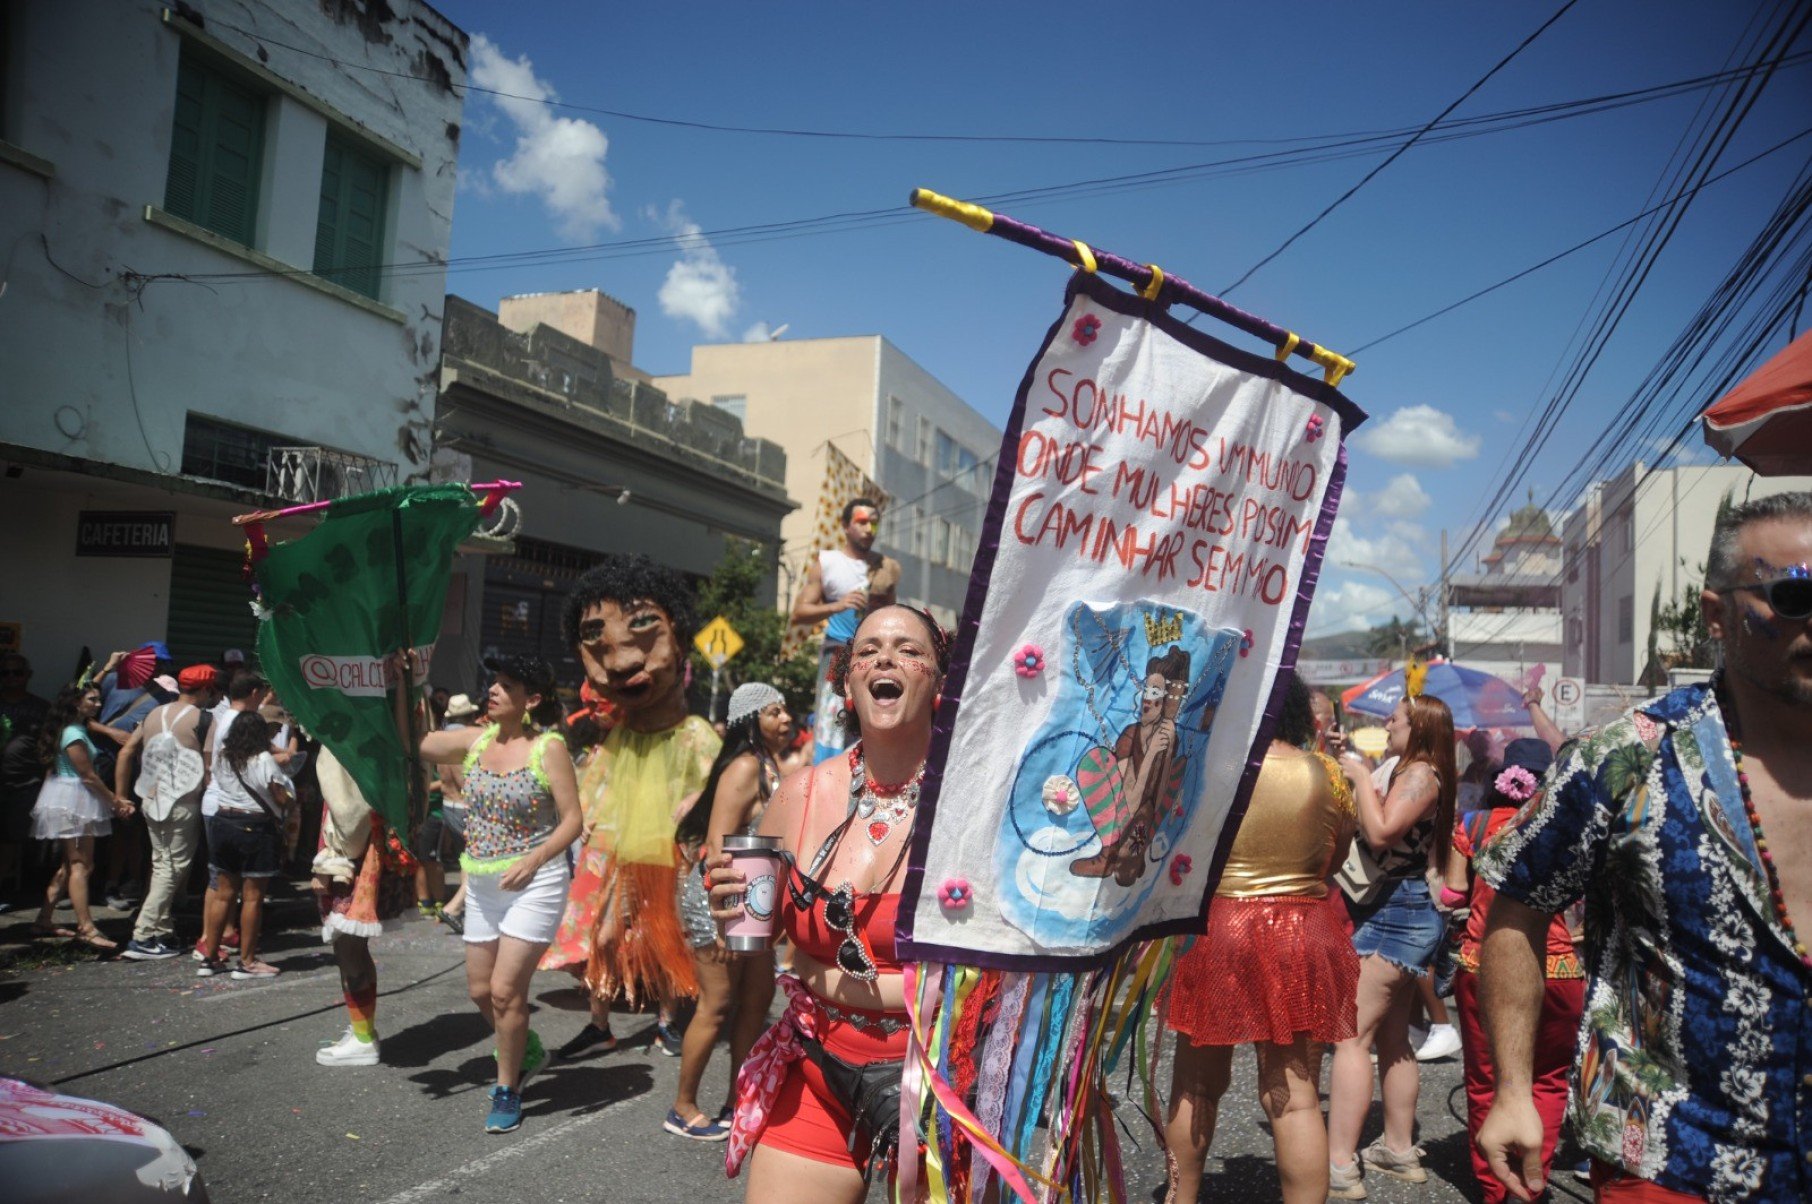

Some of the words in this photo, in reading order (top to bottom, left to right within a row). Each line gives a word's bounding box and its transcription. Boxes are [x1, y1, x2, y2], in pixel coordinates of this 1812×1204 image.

[1042, 368, 1210, 471] SONHAMOS
[81, 522, 169, 546] CAFETERIA
[1016, 430, 1104, 495] ONDE
[1113, 460, 1236, 537] MULHERES
[1013, 492, 1186, 583] CAMINHAR
[1187, 539, 1245, 595] SEM
[1561, 684, 1572, 701] E
